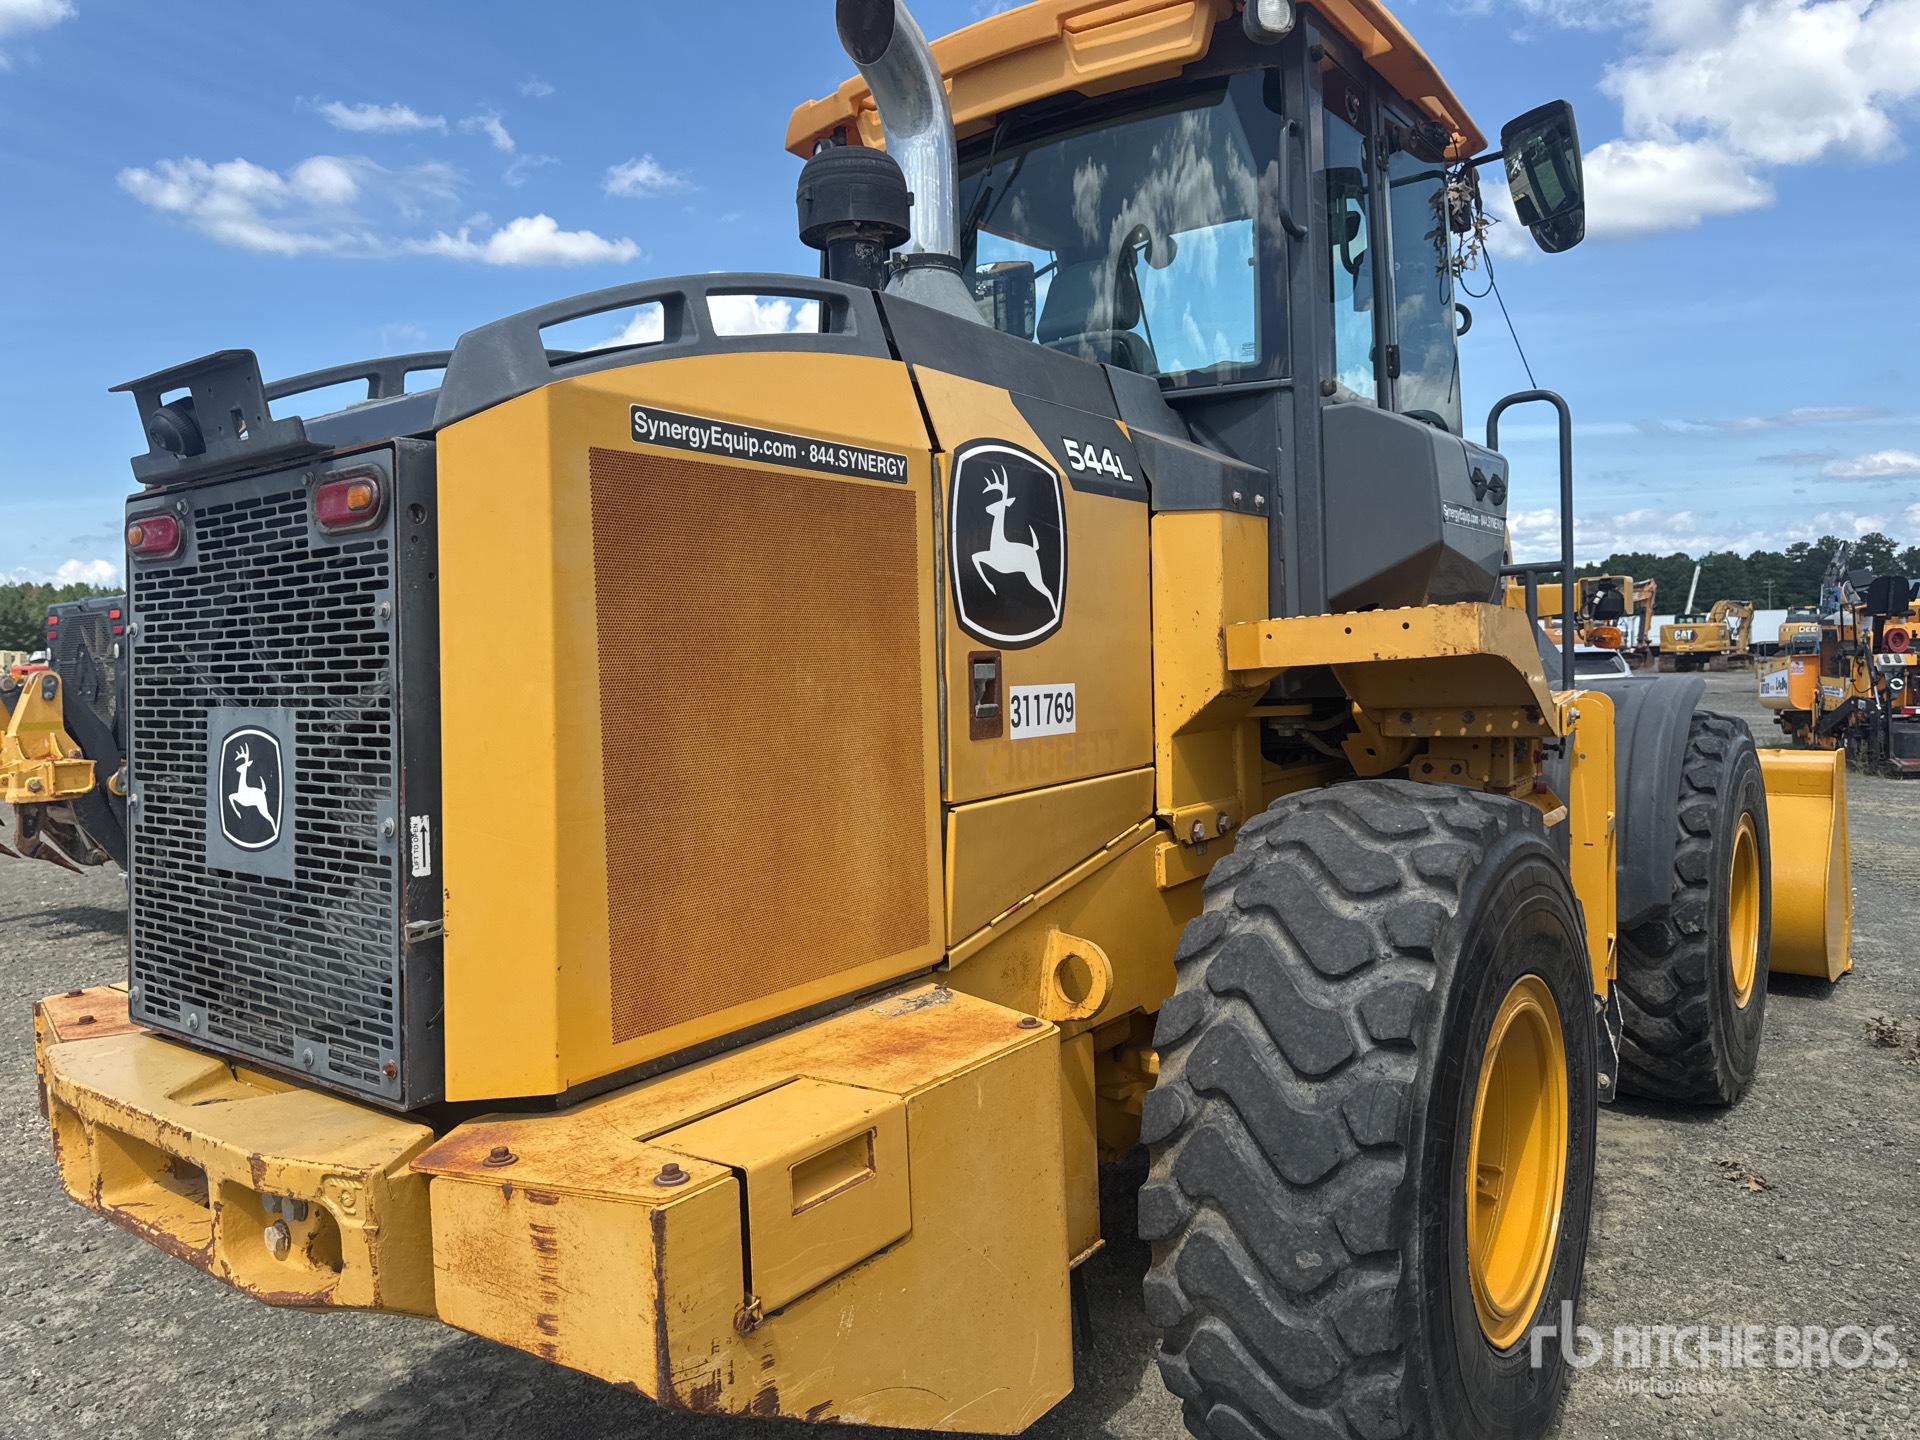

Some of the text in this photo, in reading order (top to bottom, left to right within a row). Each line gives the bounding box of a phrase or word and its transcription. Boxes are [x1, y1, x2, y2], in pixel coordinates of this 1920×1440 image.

[634, 410, 906, 477] SynergyEquip.com 844.SYNERGY
[1062, 437, 1134, 482] 544L
[1674, 629, 1693, 641] CAT
[1010, 691, 1074, 729] 311769
[413, 844, 420, 854] TO
